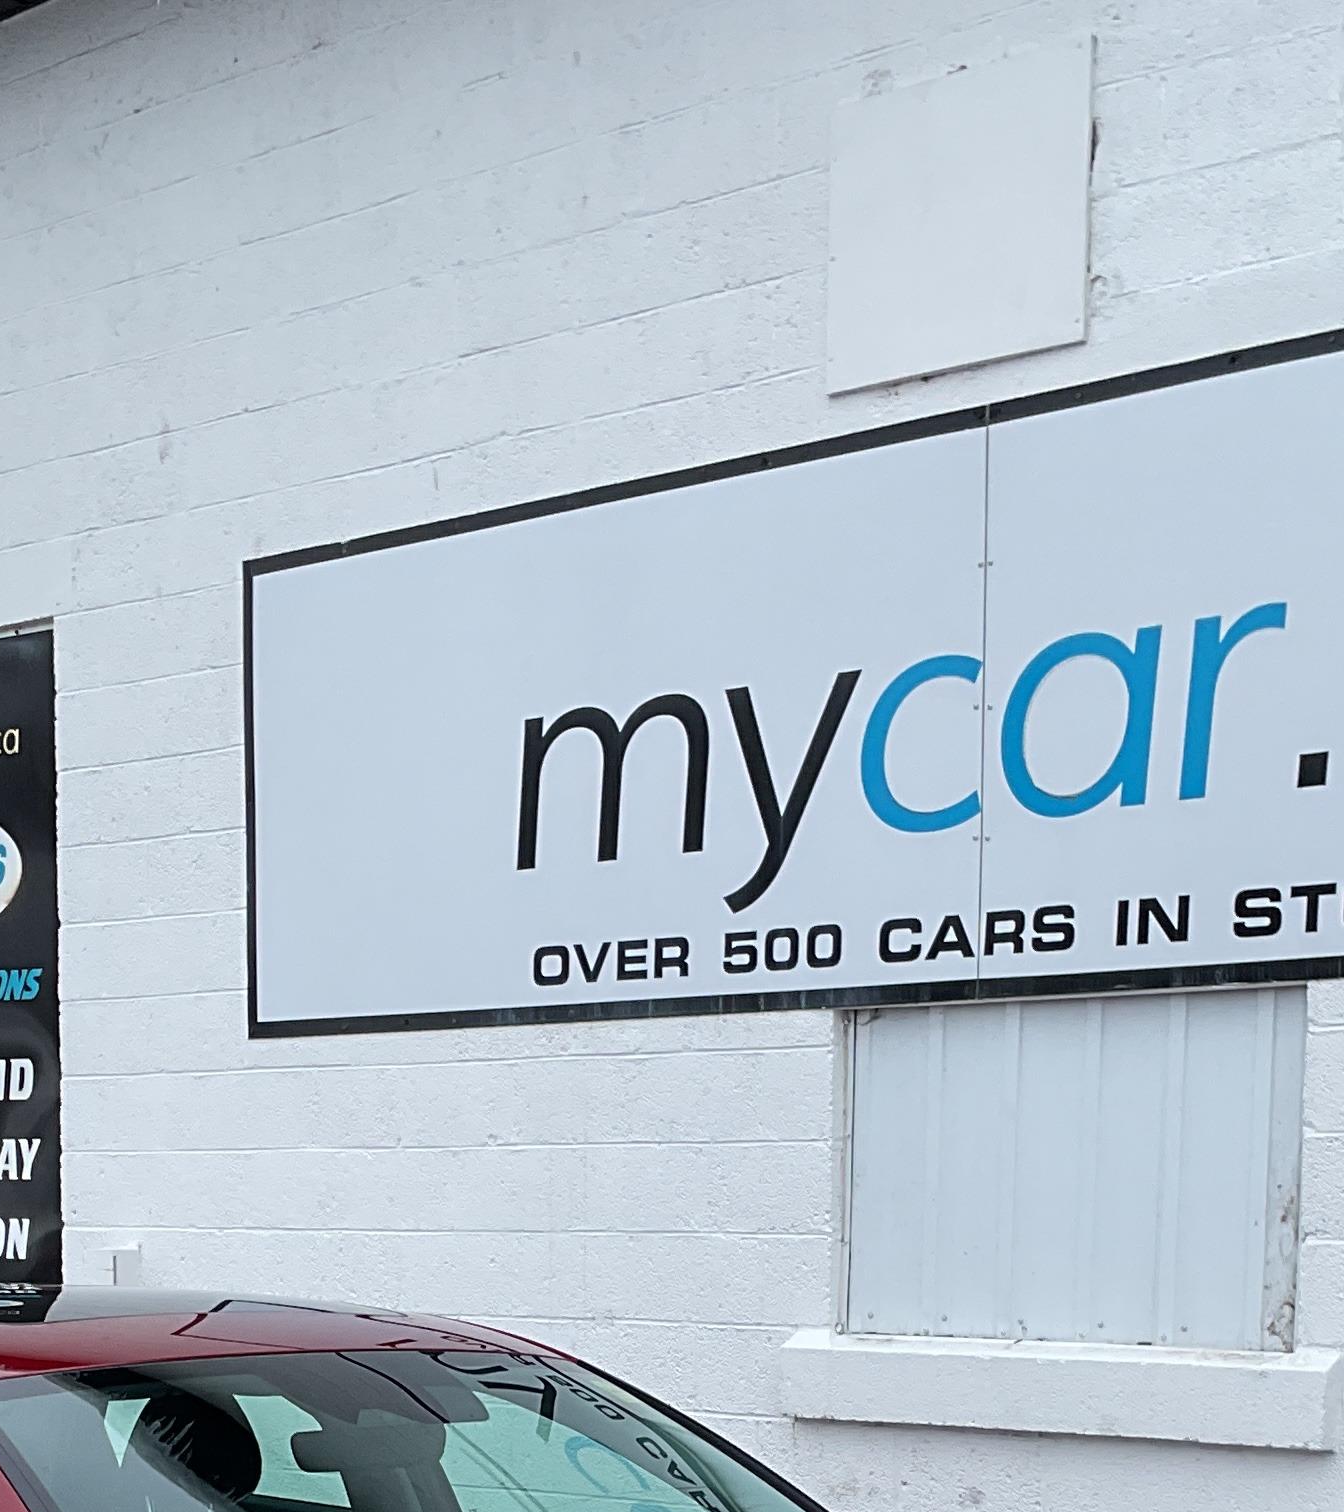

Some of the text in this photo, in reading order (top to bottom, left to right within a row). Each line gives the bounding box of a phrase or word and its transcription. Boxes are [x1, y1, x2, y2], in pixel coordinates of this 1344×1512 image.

[533, 936, 690, 987] OVER
[722, 924, 843, 974] 500
[879, 904, 1076, 963] CARS
[1115, 894, 1192, 946] IN
